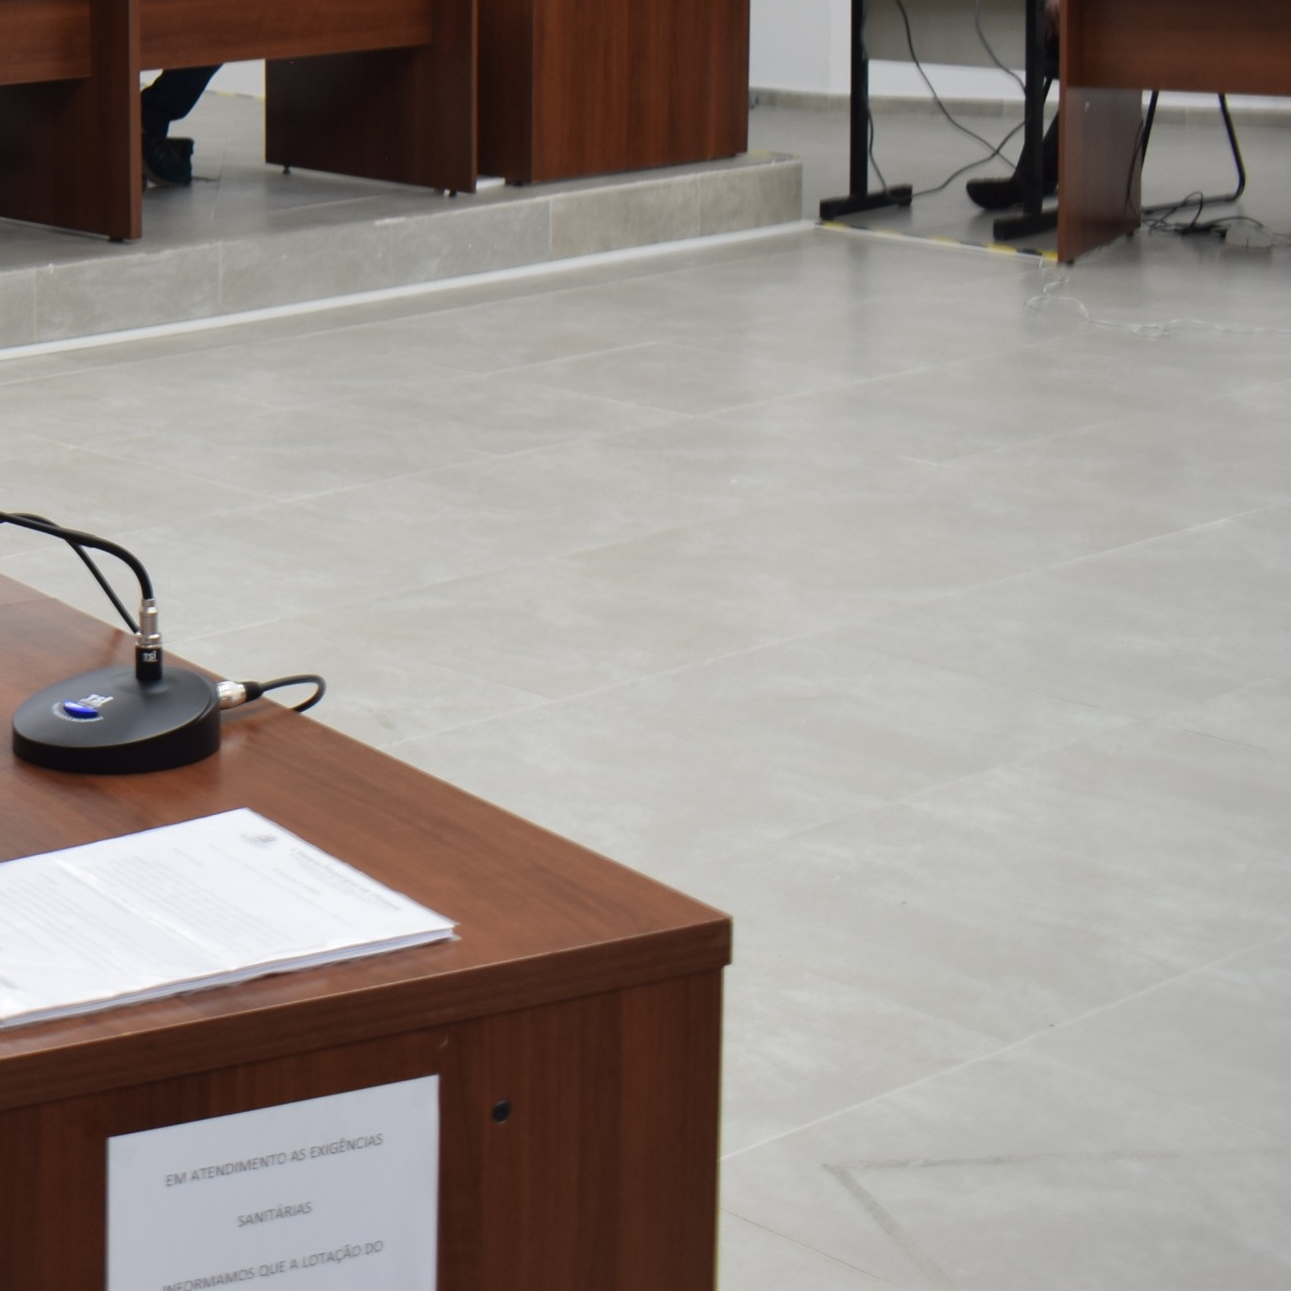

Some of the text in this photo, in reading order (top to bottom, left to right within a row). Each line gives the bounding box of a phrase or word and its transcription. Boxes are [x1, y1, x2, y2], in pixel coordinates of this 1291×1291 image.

[165, 1132, 384, 1187] EM ATENDIMENTO AS EXIGÊNCIAS
[236, 1201, 313, 1228] SANITÁRIAS
[258, 1260, 286, 1277] QUE
[290, 1258, 300, 1270] A
[301, 1244, 361, 1269] LOTAÇÃO
[365, 1239, 384, 1255] DO
